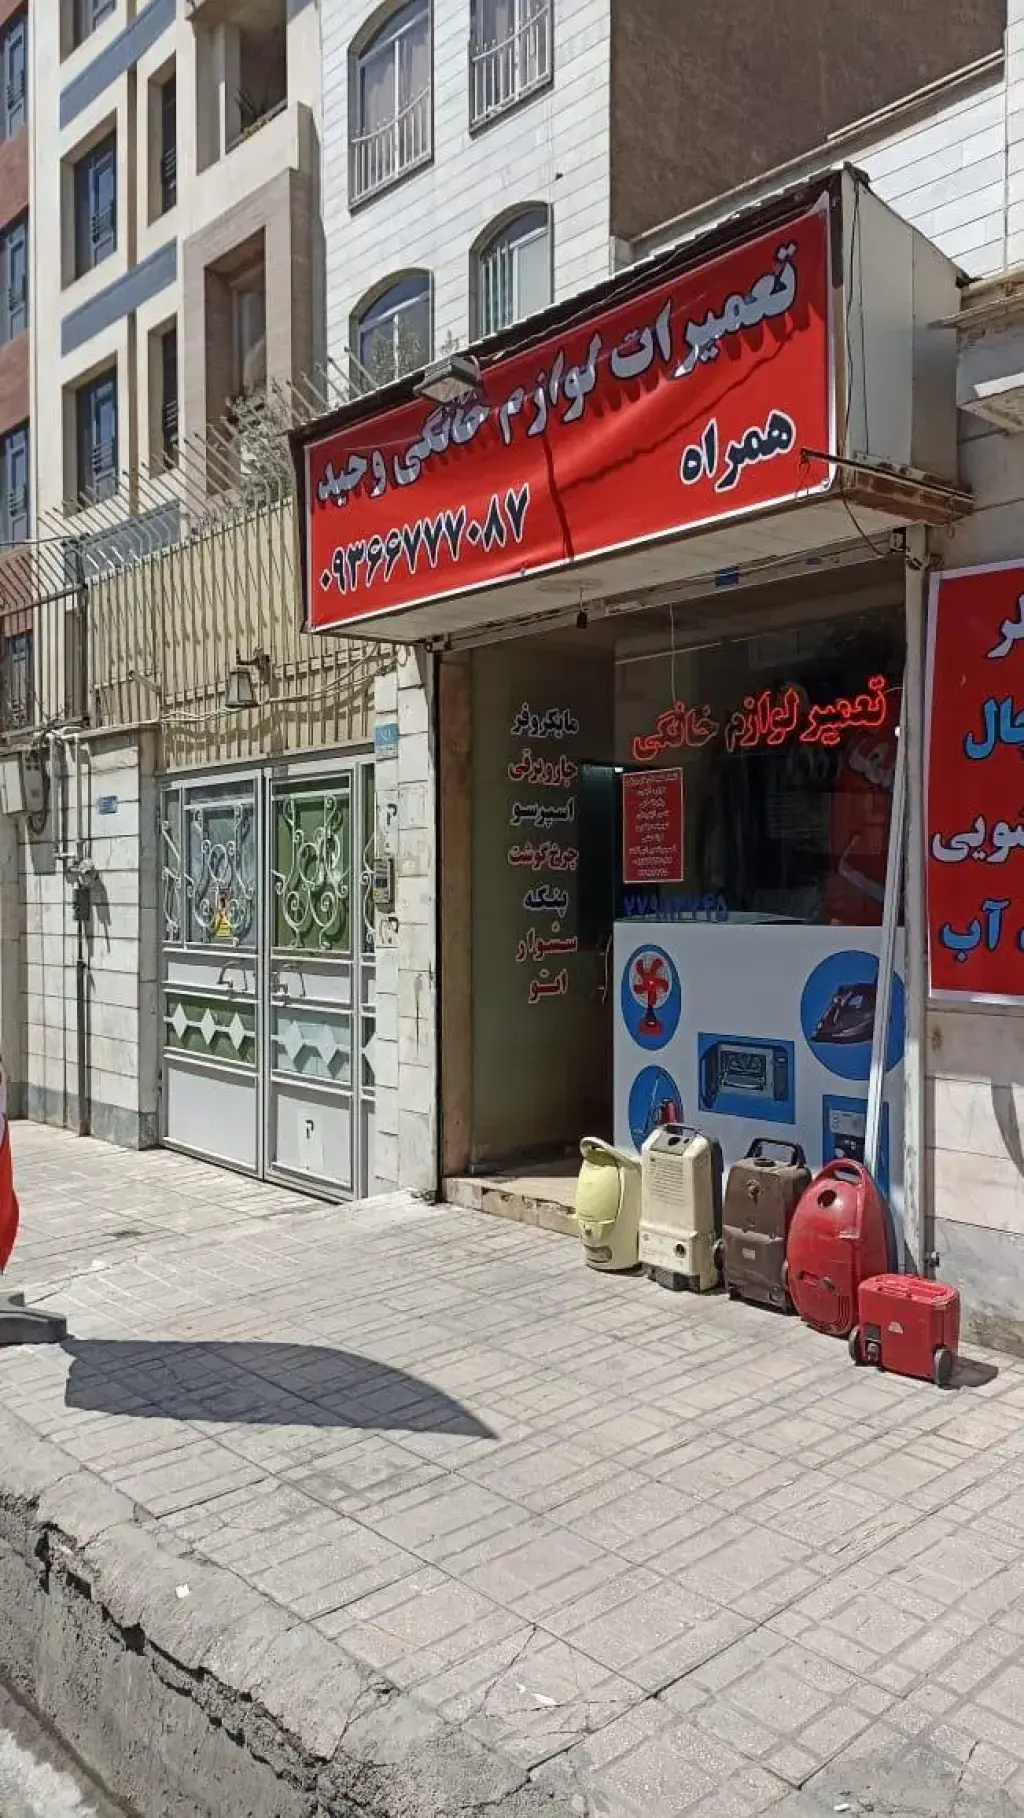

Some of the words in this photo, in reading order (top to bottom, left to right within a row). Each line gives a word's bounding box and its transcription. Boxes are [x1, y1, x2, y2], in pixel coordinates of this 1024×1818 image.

[611, 243, 796, 379] تعمیرات
[500, 332, 602, 445] لوازم
[317, 450, 386, 507] وحید
[680, 409, 796, 492] همراه
[320, 483, 530, 594] ۰۹۳۶۶۷۷۷۰۸۷
[632, 700, 720, 761] خانگی
[725, 686, 800, 751] لوازم
[799, 675, 887, 745] تعمیر
[510, 797, 575, 830] اسپرسو
[524, 884, 568, 918] پنکه
[939, 898, 1011, 962] آب
[528, 968, 568, 1004] اتو
